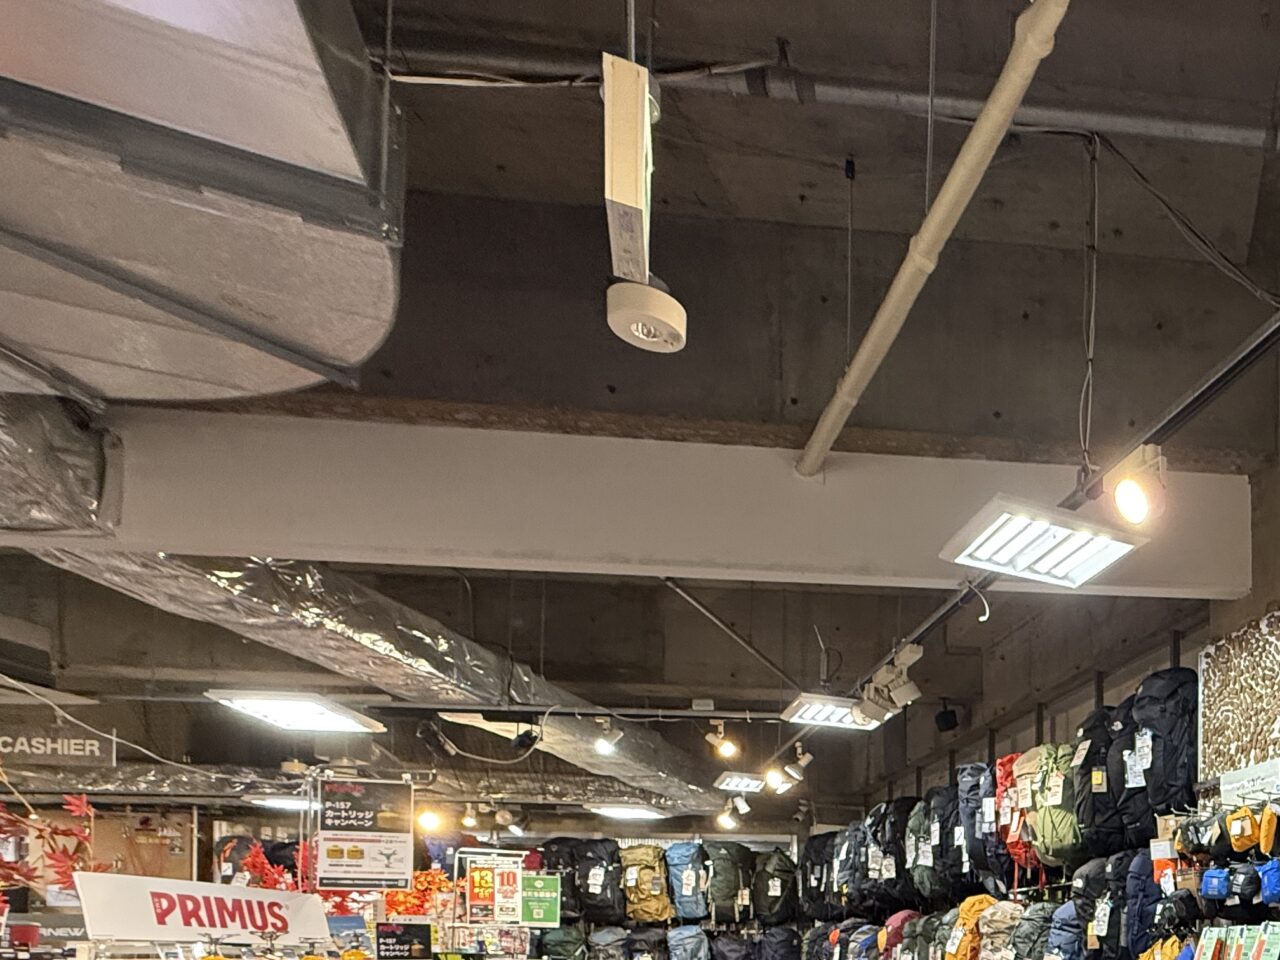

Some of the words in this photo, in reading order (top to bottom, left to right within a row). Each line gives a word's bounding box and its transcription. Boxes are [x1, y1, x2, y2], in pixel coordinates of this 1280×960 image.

[0, 736, 101, 757] CASHIER
[325, 810, 374, 819] カートリッジ
[325, 818, 374, 828] キャンペーン
[470, 869, 494, 888] 13
[149, 891, 290, 933] PRIMUS
